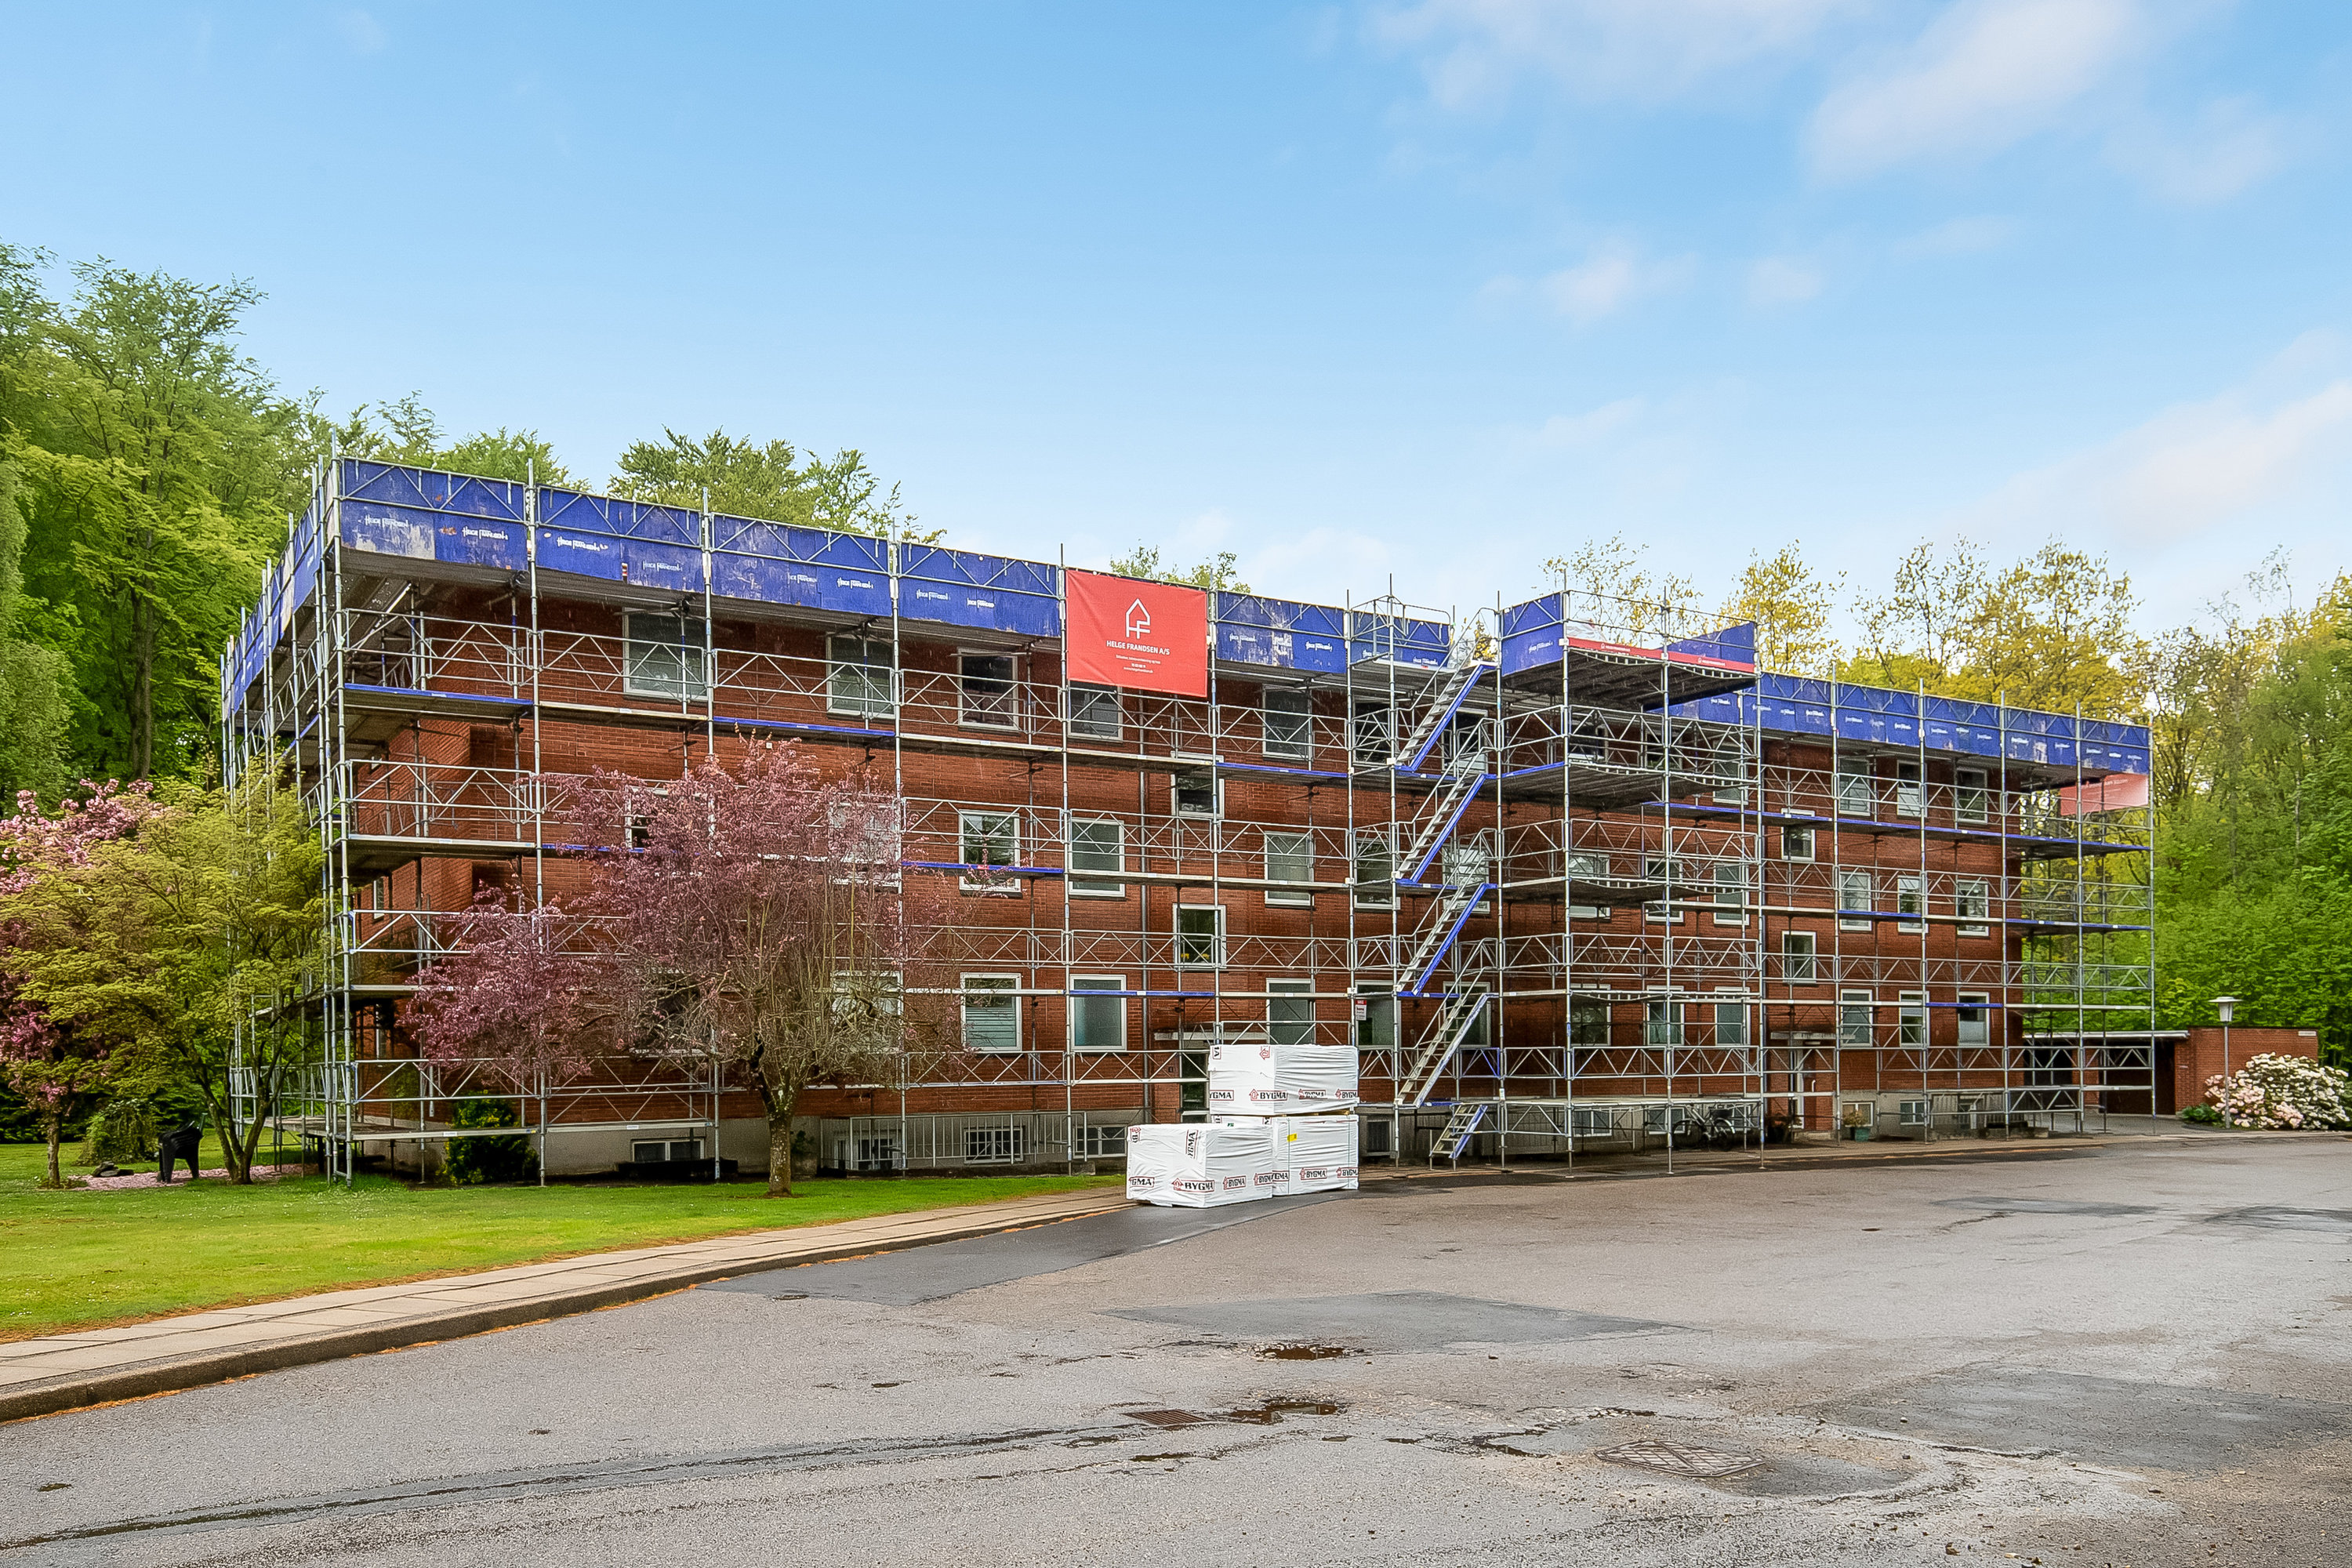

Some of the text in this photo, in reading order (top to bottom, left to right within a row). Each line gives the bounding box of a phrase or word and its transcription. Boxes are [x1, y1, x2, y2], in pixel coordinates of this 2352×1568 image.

[1106, 640, 1126, 649] HELGE
[1127, 643, 1158, 654] FRANDSEN
[1306, 1170, 1326, 1178] BYGMA
[1229, 1178, 1245, 1187] BYGMA
